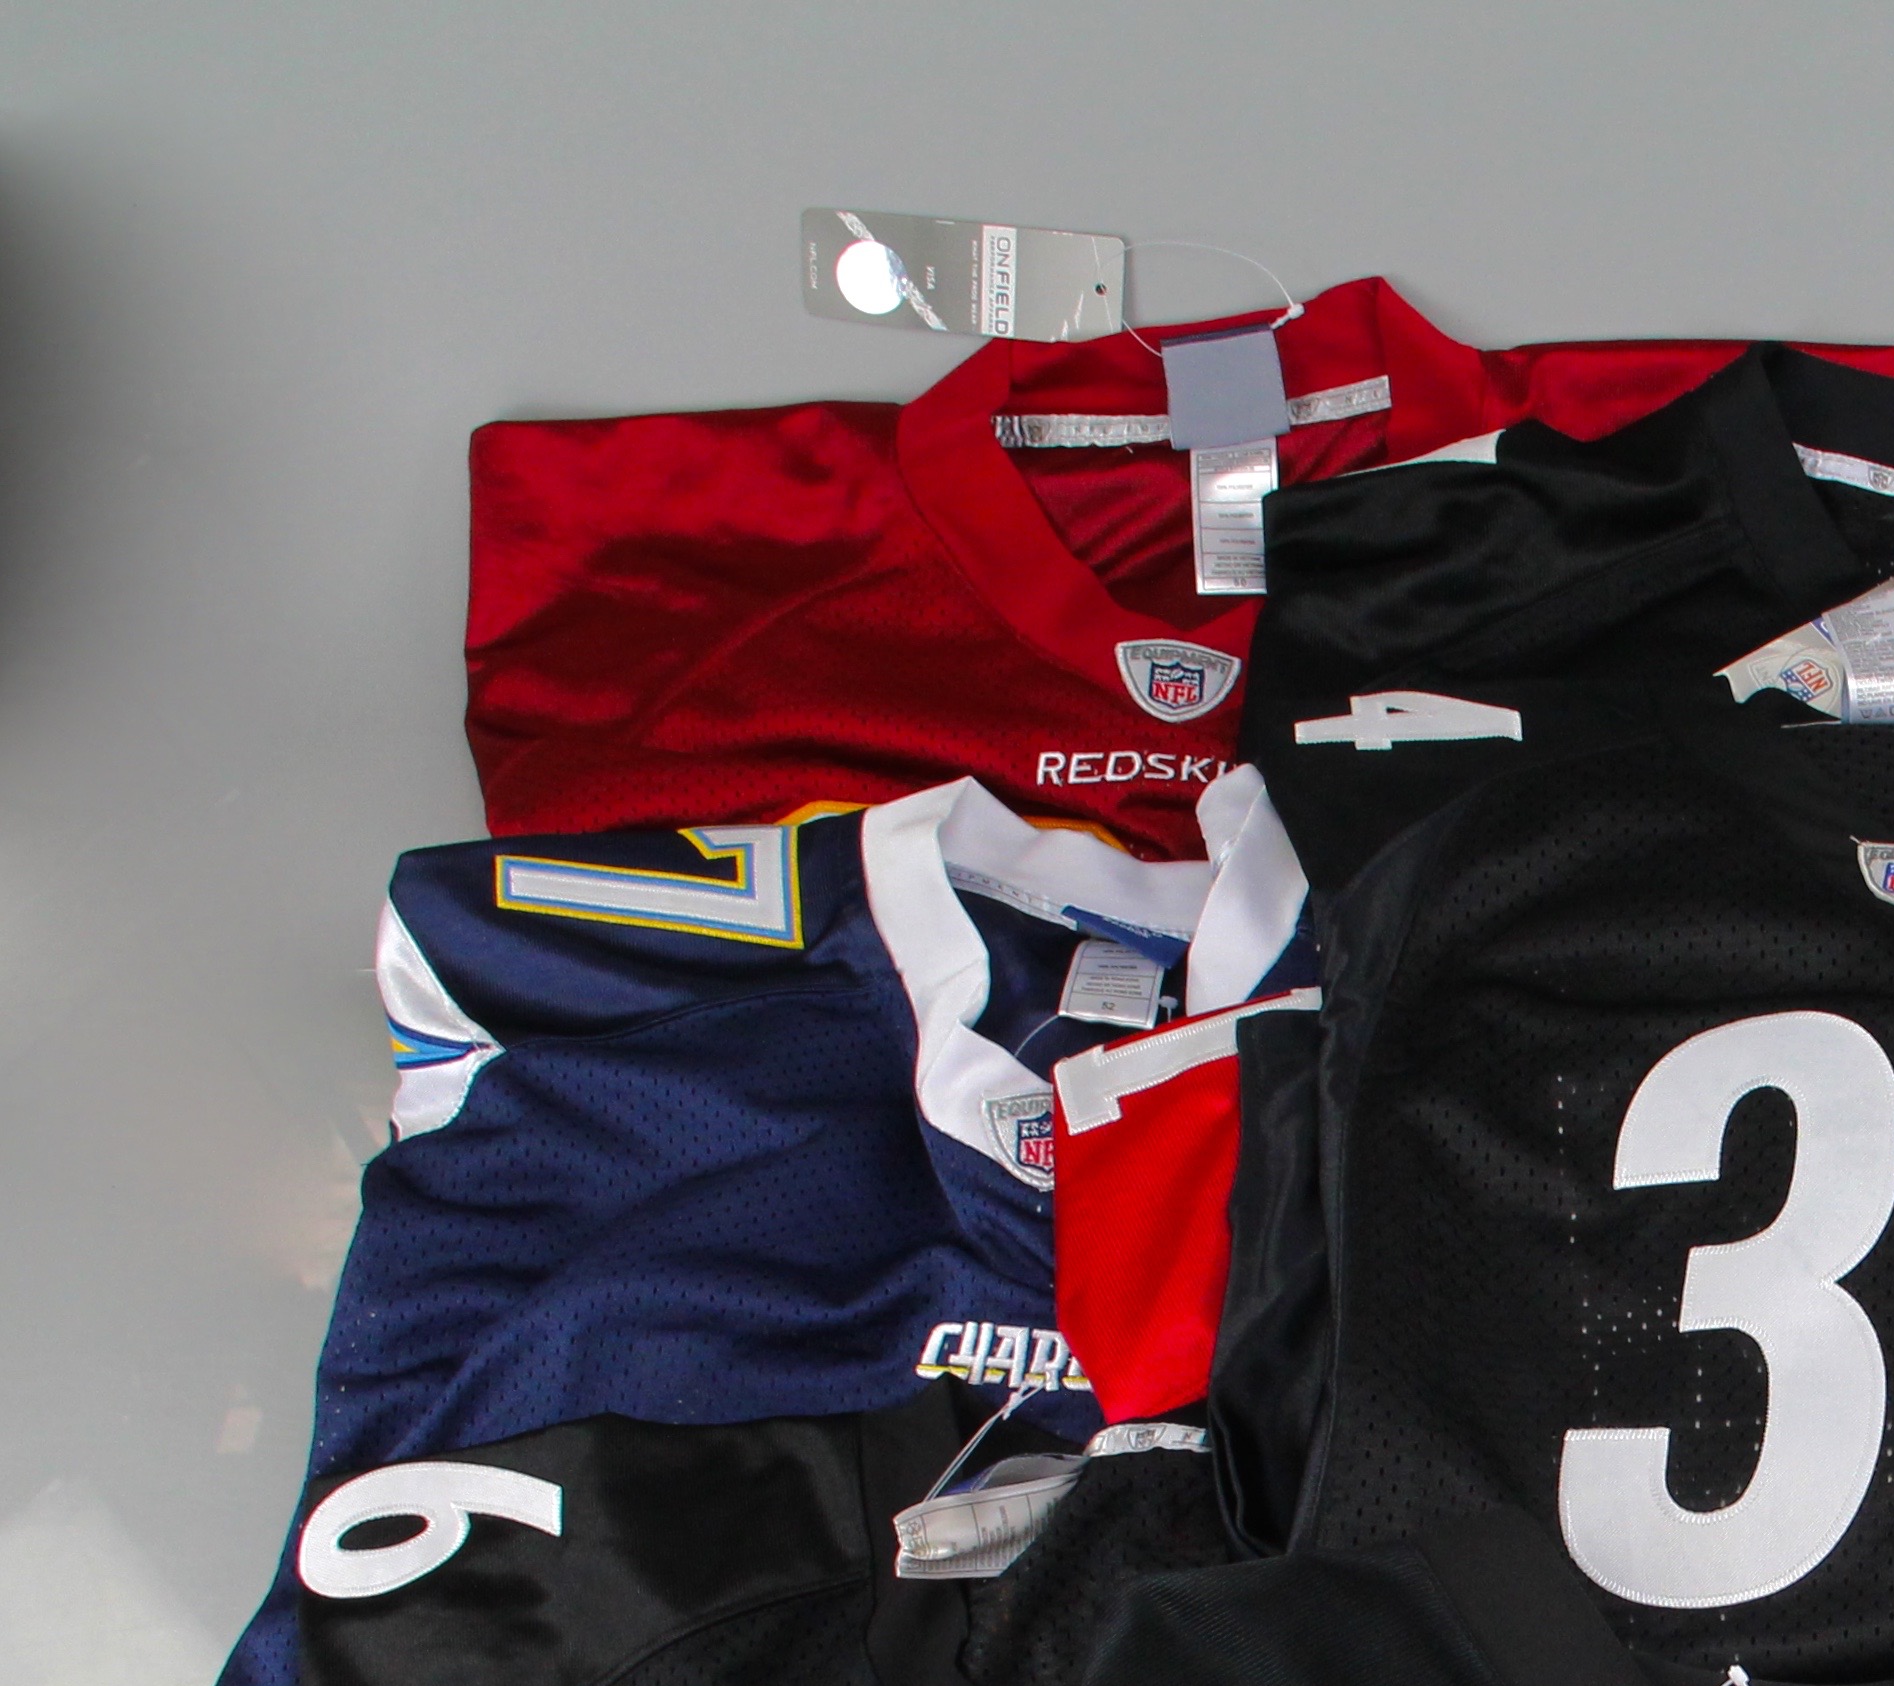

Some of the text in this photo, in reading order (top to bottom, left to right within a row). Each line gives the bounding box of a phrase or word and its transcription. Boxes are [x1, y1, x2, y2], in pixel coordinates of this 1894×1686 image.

[808, 241, 818, 291] NFL.COM
[925, 265, 936, 291] VISA
[994, 235, 1012, 335] ONFIELD
[1130, 646, 1230, 675] EQUIPMENT
[1795, 661, 1829, 692] NFL
[1151, 681, 1199, 704] NFL
[1294, 691, 1523, 751] 4
[1036, 750, 1238, 787] REDSKI
